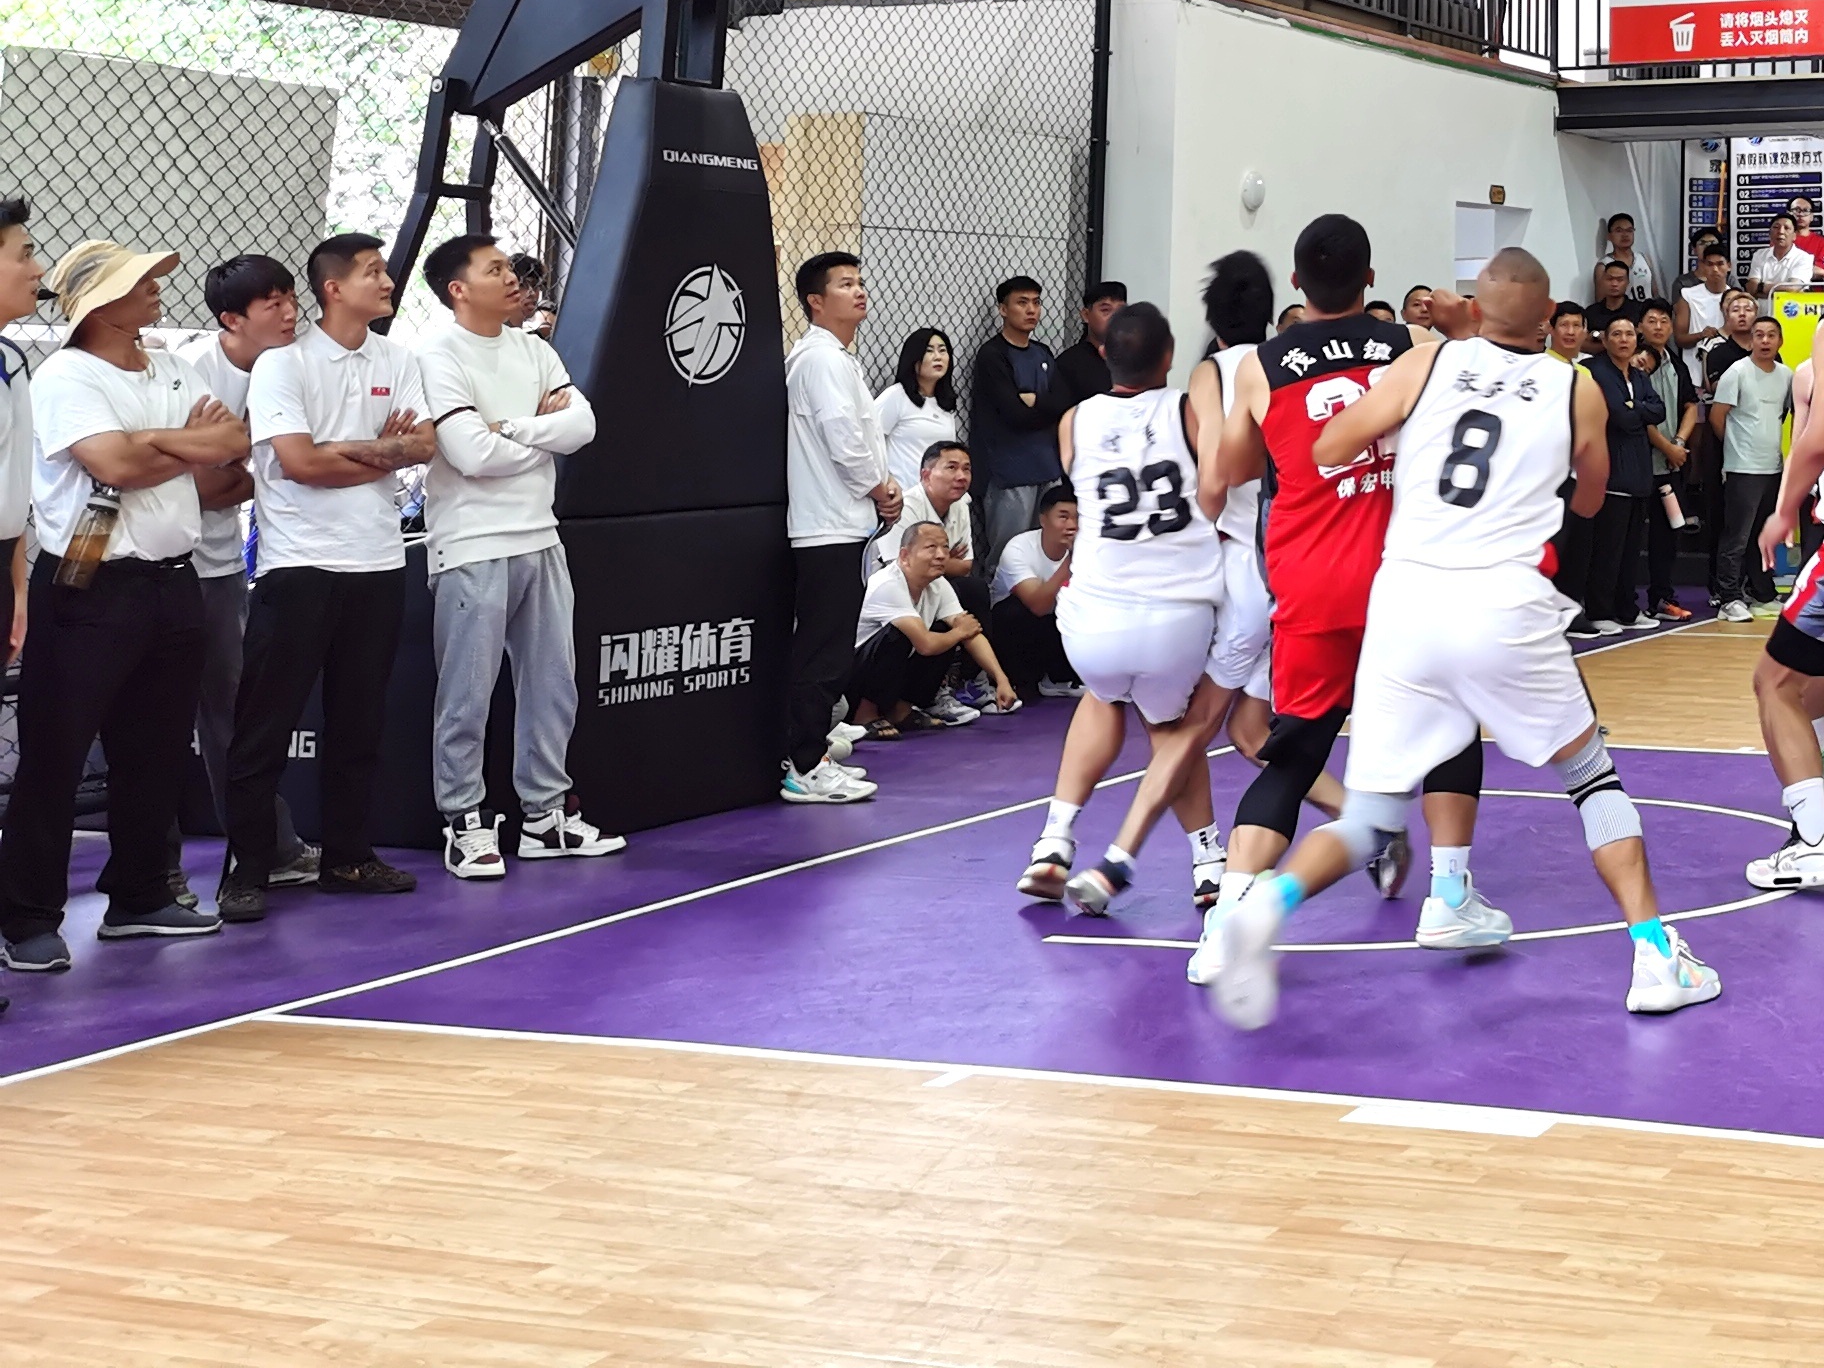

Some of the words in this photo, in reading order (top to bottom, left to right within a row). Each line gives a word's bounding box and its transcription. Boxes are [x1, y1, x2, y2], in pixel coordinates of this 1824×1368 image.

[1719, 9, 1809, 29] 请将烟头熄灭
[1719, 27, 1809, 47] 丢入灭烟筒内
[662, 149, 759, 171] QIANGMENG
[1738, 176, 1750, 185] 01
[1738, 190, 1750, 199] 02
[1738, 204, 1750, 213] 03
[1738, 219, 1750, 227] 04
[1738, 233, 1750, 242] 05
[1738, 265, 1750, 274] 07
[1279, 337, 1394, 378] 茂山镇
[1438, 408, 1502, 509] 8
[1096, 459, 1193, 541] 23
[599, 616, 756, 684] 闪耀体育
[597, 678, 675, 707] SHINING
[683, 666, 751, 694] SPORTS
